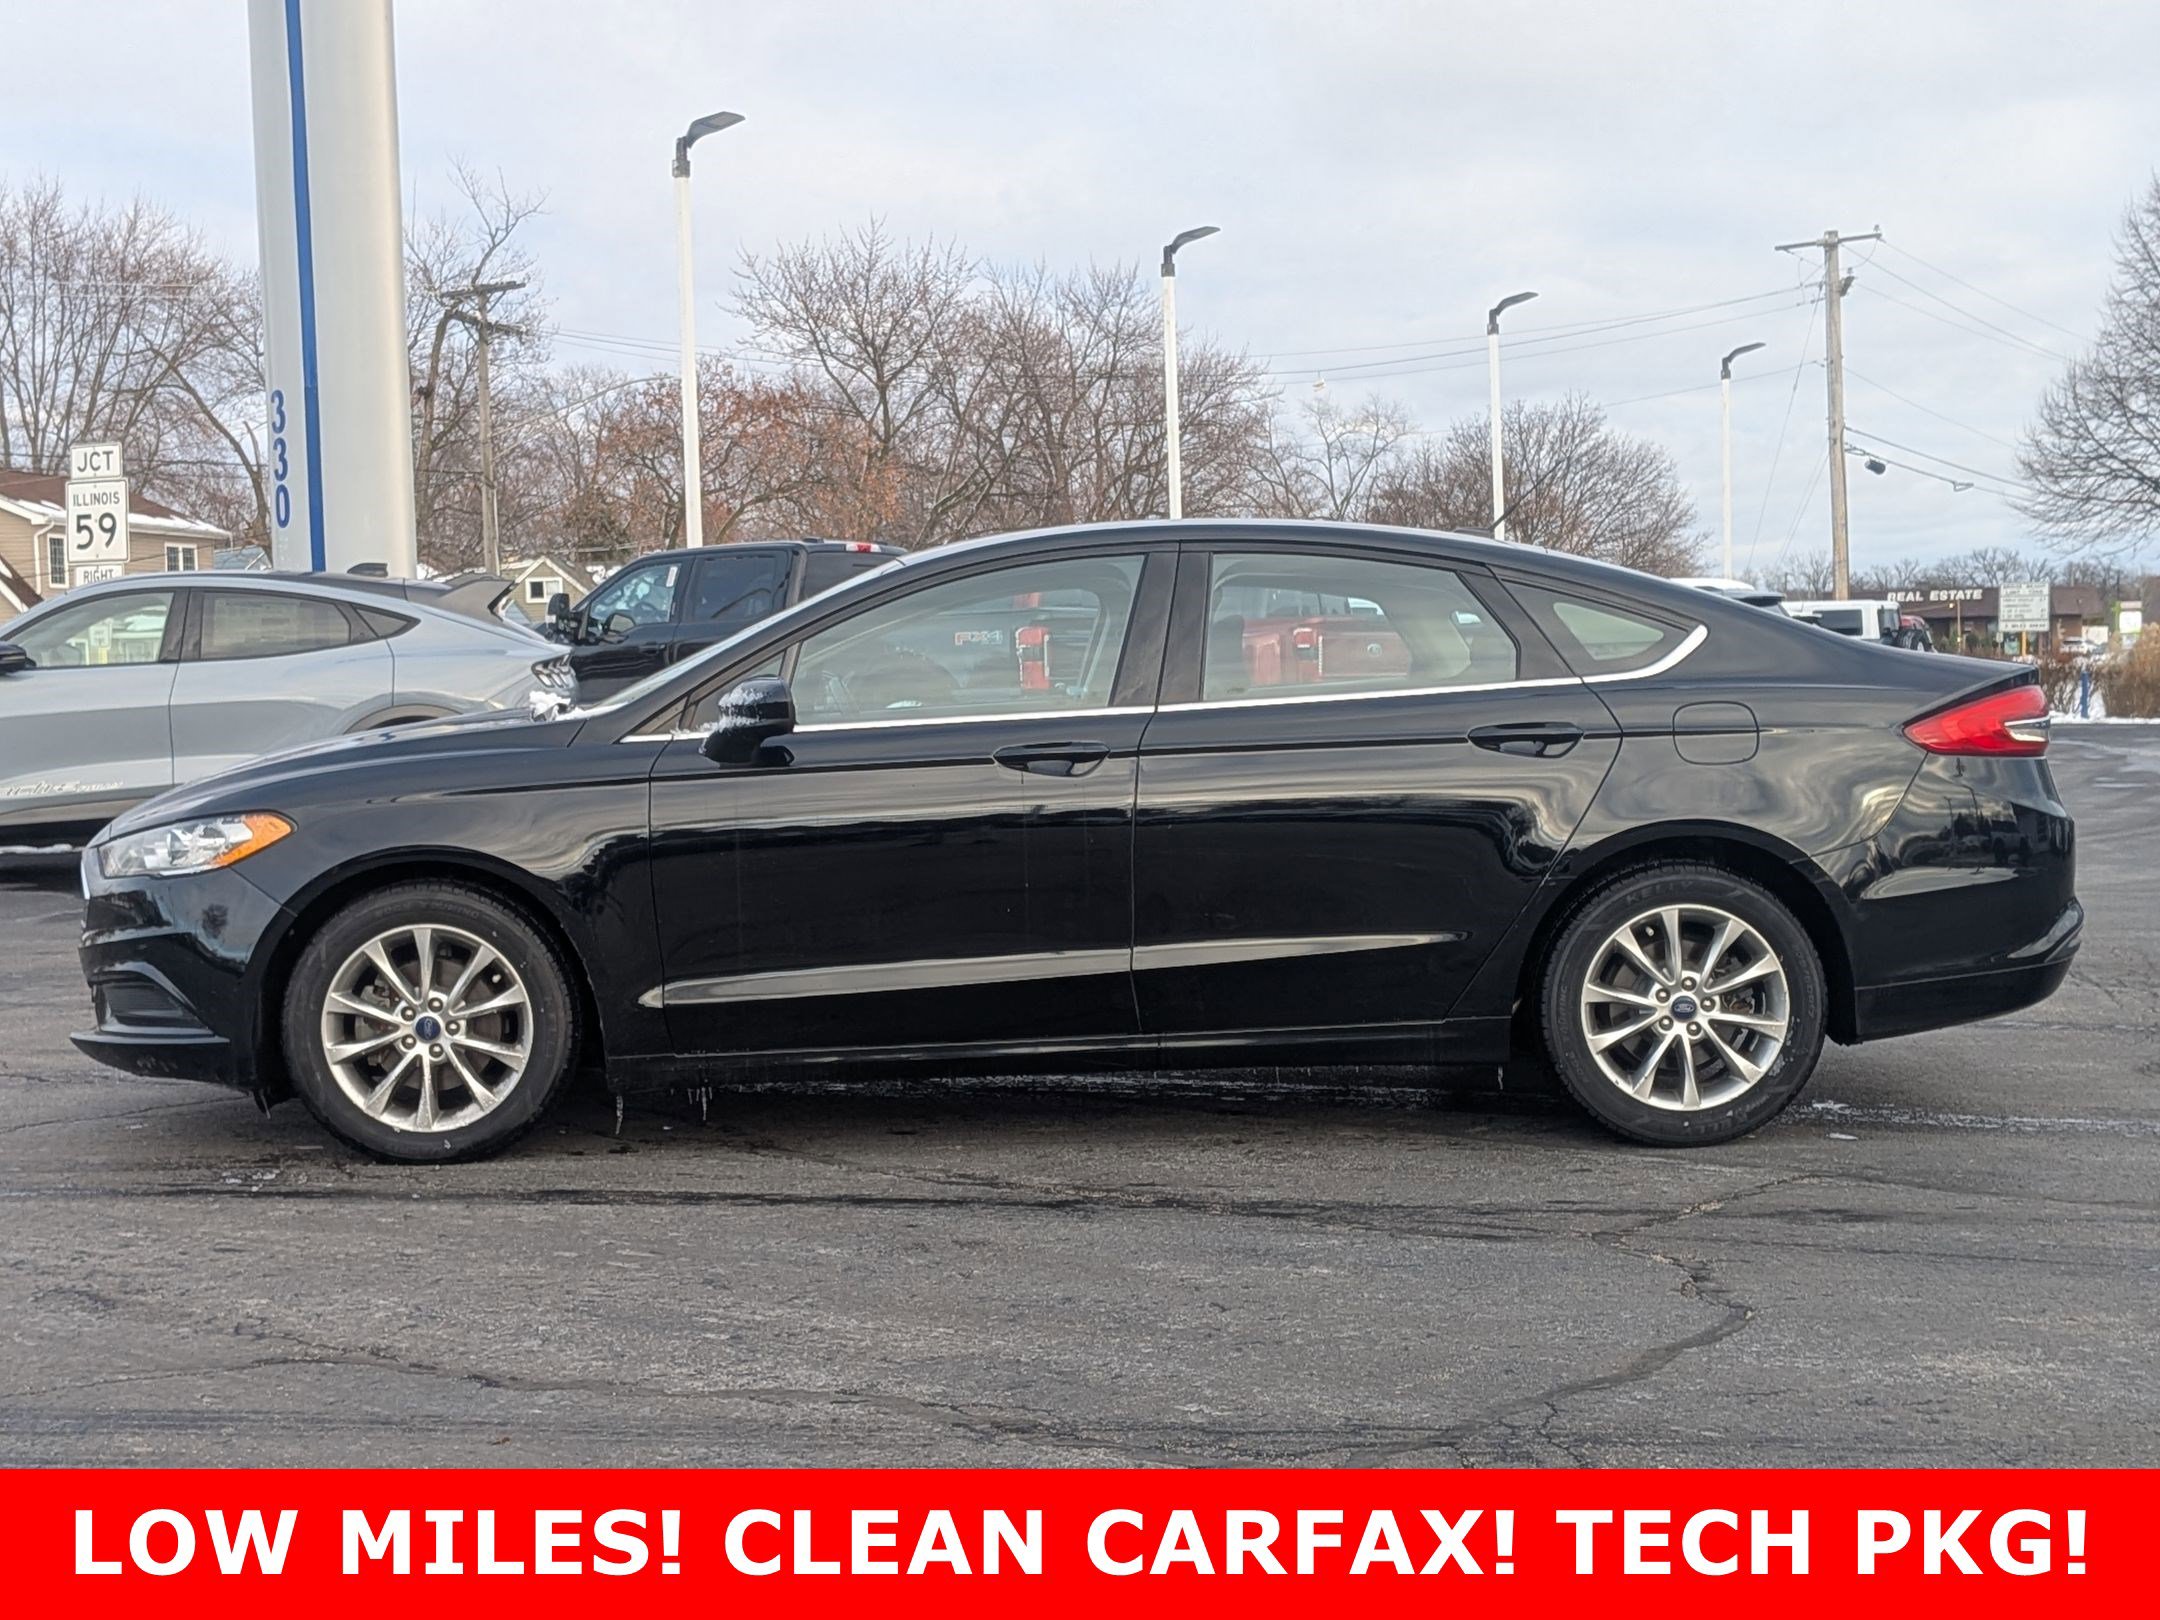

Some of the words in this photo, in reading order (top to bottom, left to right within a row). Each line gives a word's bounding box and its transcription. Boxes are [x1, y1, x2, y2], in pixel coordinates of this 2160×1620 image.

[77, 450, 114, 473] JCT
[270, 389, 291, 529] 330
[72, 491, 120, 507] ILLINOIS
[76, 512, 117, 550] 59
[83, 568, 114, 583] RIGHT
[1887, 590, 1924, 602] REAL
[1929, 588, 1983, 601] ESTATE
